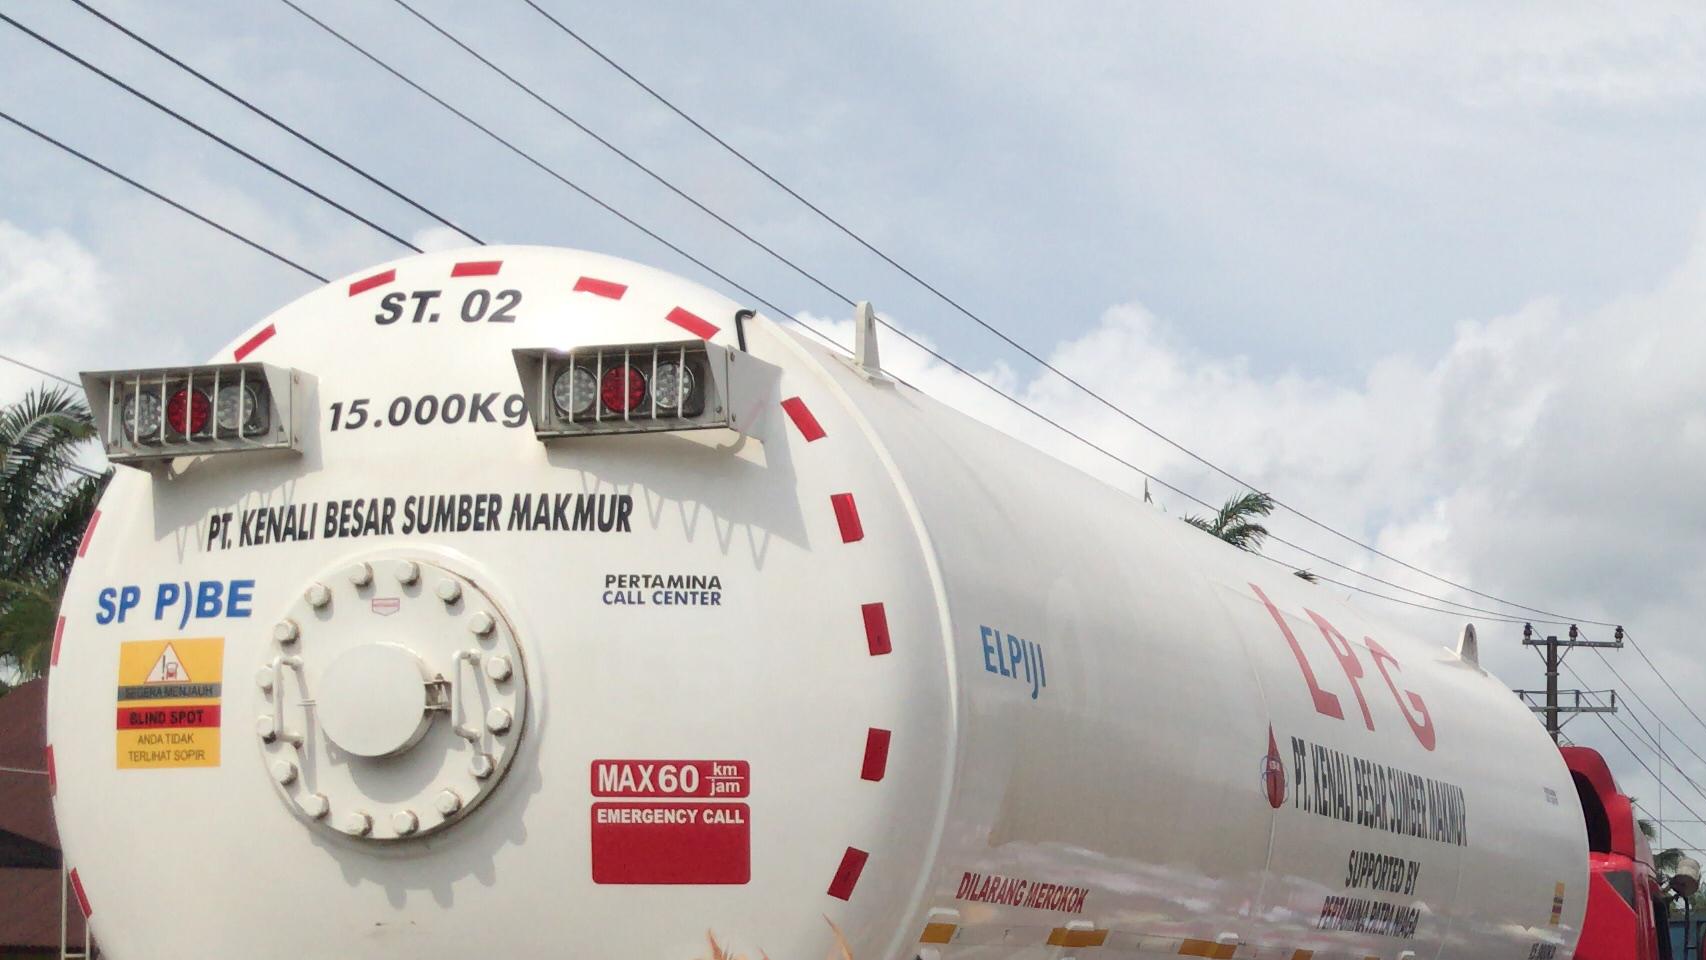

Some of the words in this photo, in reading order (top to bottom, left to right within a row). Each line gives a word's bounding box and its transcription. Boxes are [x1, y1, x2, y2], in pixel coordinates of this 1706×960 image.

[375, 290, 442, 325] ST.
[460, 289, 522, 324] 02
[330, 392, 530, 432] 15.000Kg
[207, 514, 233, 552] PT.
[239, 502, 317, 547] KENALI
[323, 497, 394, 540] BESAR
[401, 495, 502, 534] SUMBER
[507, 493, 634, 533] MAKMUR
[602, 590, 646, 606] CALL
[652, 590, 722, 606] CENTER
[605, 574, 722, 590] PERTAMINA
[980, 624, 1046, 700] ELPIJI
[1248, 582, 1436, 752] LPG
[129, 710, 166, 726] BLIND
[170, 709, 204, 724] SPOT
[128, 749, 171, 762] TERLIHAT
[174, 748, 206, 761] SOPIR
[137, 733, 164, 745] ANDA
[167, 732, 195, 745] TIDAK
[598, 764, 655, 793] MAX
[657, 764, 699, 793] 60
[713, 761, 738, 776] km
[709, 777, 741, 796] jam
[1310, 743, 1354, 823] KENALI
[1353, 756, 1389, 829] BESAR
[1387, 765, 1428, 840] SUMBER
[1427, 778, 1468, 847] MAKMUR
[597, 808, 699, 824] EMERGENCY
[702, 809, 745, 824] CALL
[1345, 849, 1406, 894] SUPPORTED
[1403, 861, 1421, 896] BY
[955, 871, 1028, 907] DILARANG
[1022, 881, 1090, 914] MEROKOK
